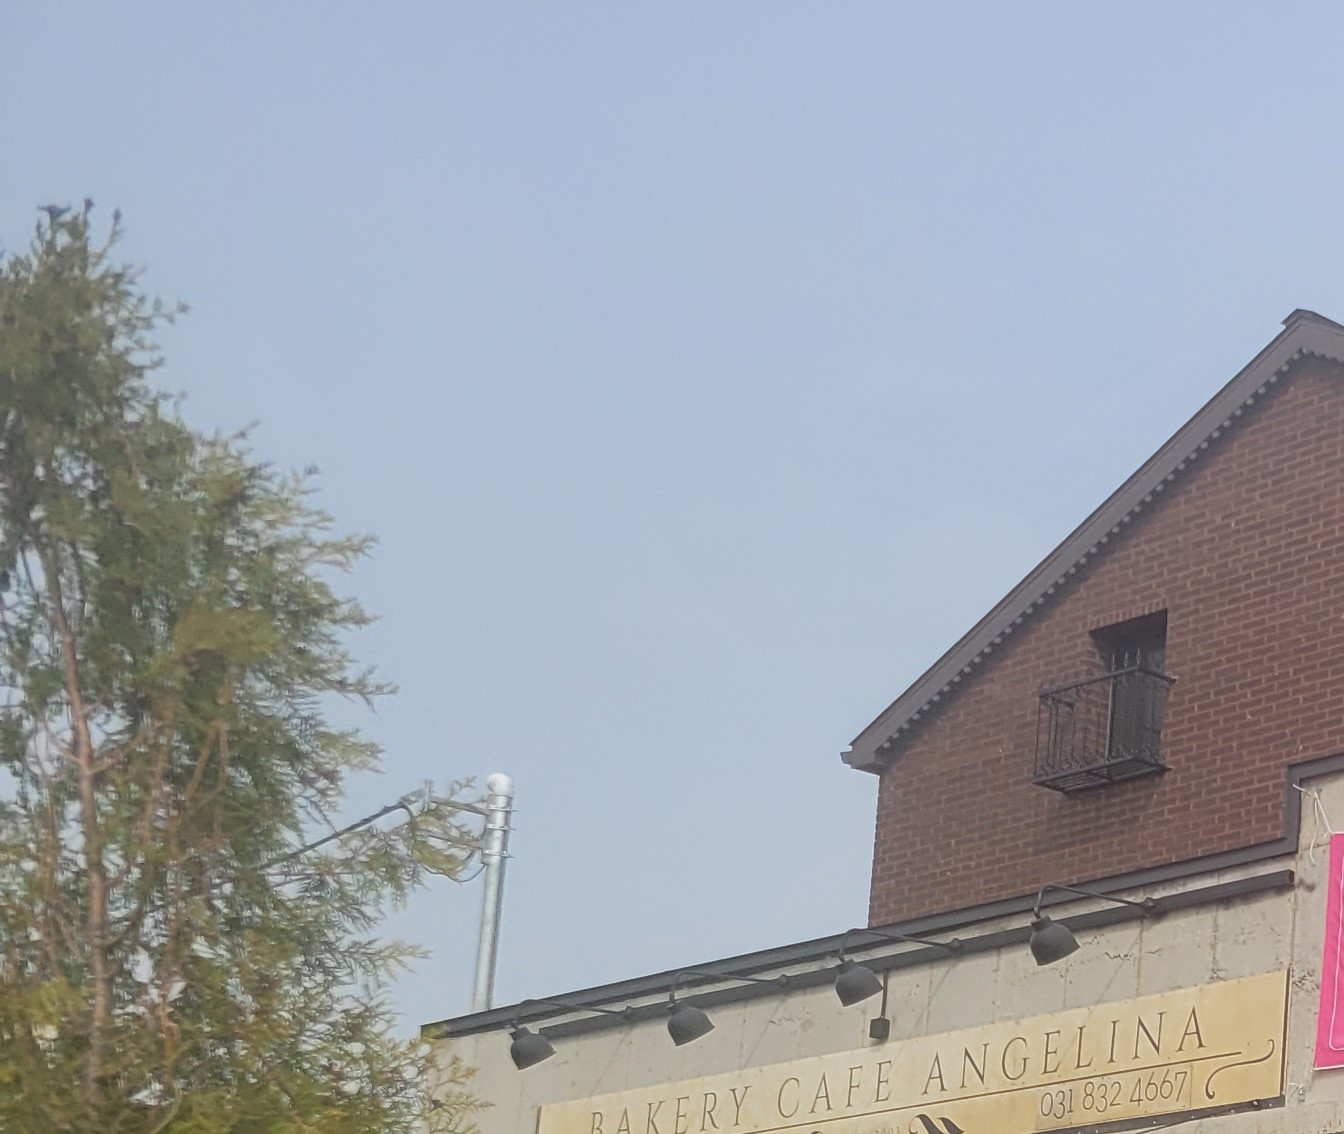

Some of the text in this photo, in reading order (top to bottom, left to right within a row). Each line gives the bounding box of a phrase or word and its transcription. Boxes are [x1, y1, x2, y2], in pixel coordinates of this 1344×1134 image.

[777, 1060, 892, 1118] CAFE
[920, 1005, 1207, 1095] ANGELINA
[1040, 1069, 1188, 1120] 031 832 4667
